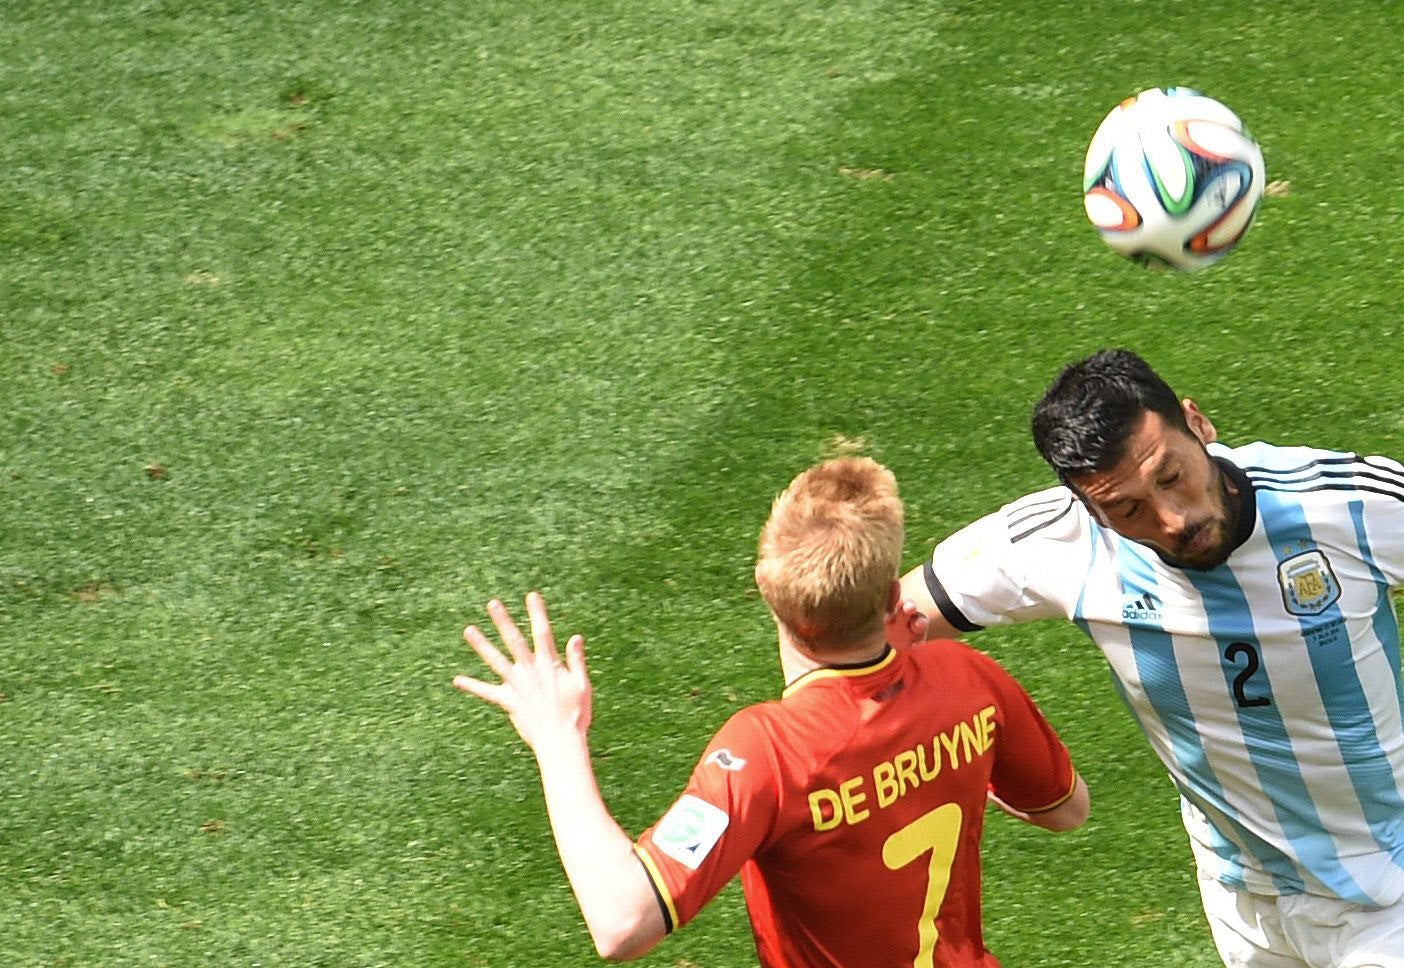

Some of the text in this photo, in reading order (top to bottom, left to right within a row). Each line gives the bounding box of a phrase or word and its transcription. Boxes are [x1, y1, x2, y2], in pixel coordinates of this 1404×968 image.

[1224, 642, 1271, 707] 2
[808, 706, 996, 831] DE BRUYNE
